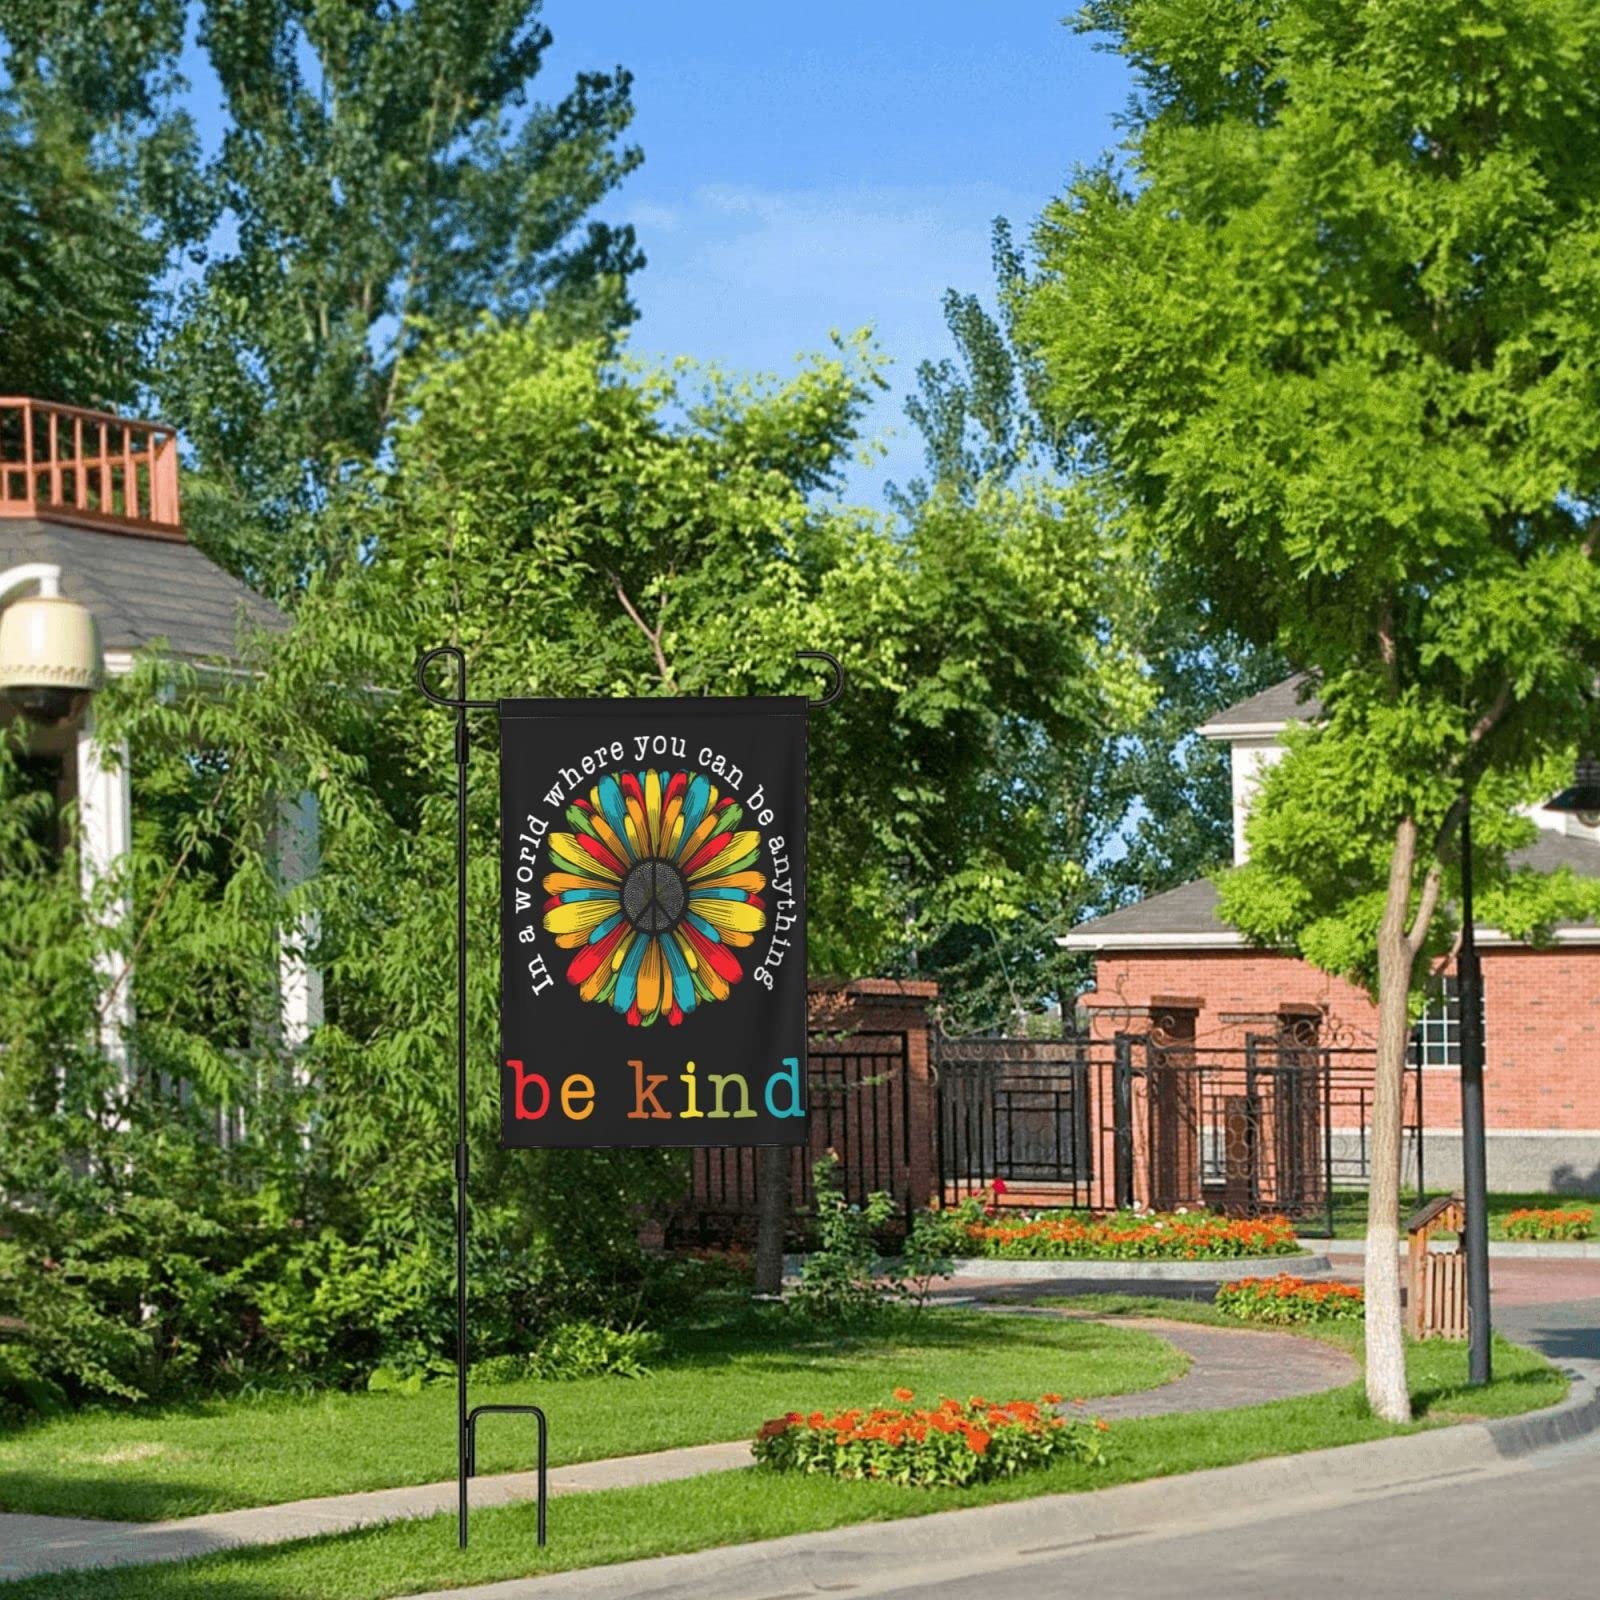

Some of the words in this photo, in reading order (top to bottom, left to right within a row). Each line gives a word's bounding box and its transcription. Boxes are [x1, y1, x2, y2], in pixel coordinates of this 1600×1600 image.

[633, 735, 687, 762] you
[698, 747, 744, 791] can
[542, 741, 625, 808] where
[746, 783, 775, 826] be
[515, 814, 550, 914] world
[518, 924, 536, 944] a
[753, 835, 798, 991] anything
[527, 953, 555, 997] In
[505, 1058, 597, 1122] be
[626, 1057, 806, 1120] kind
